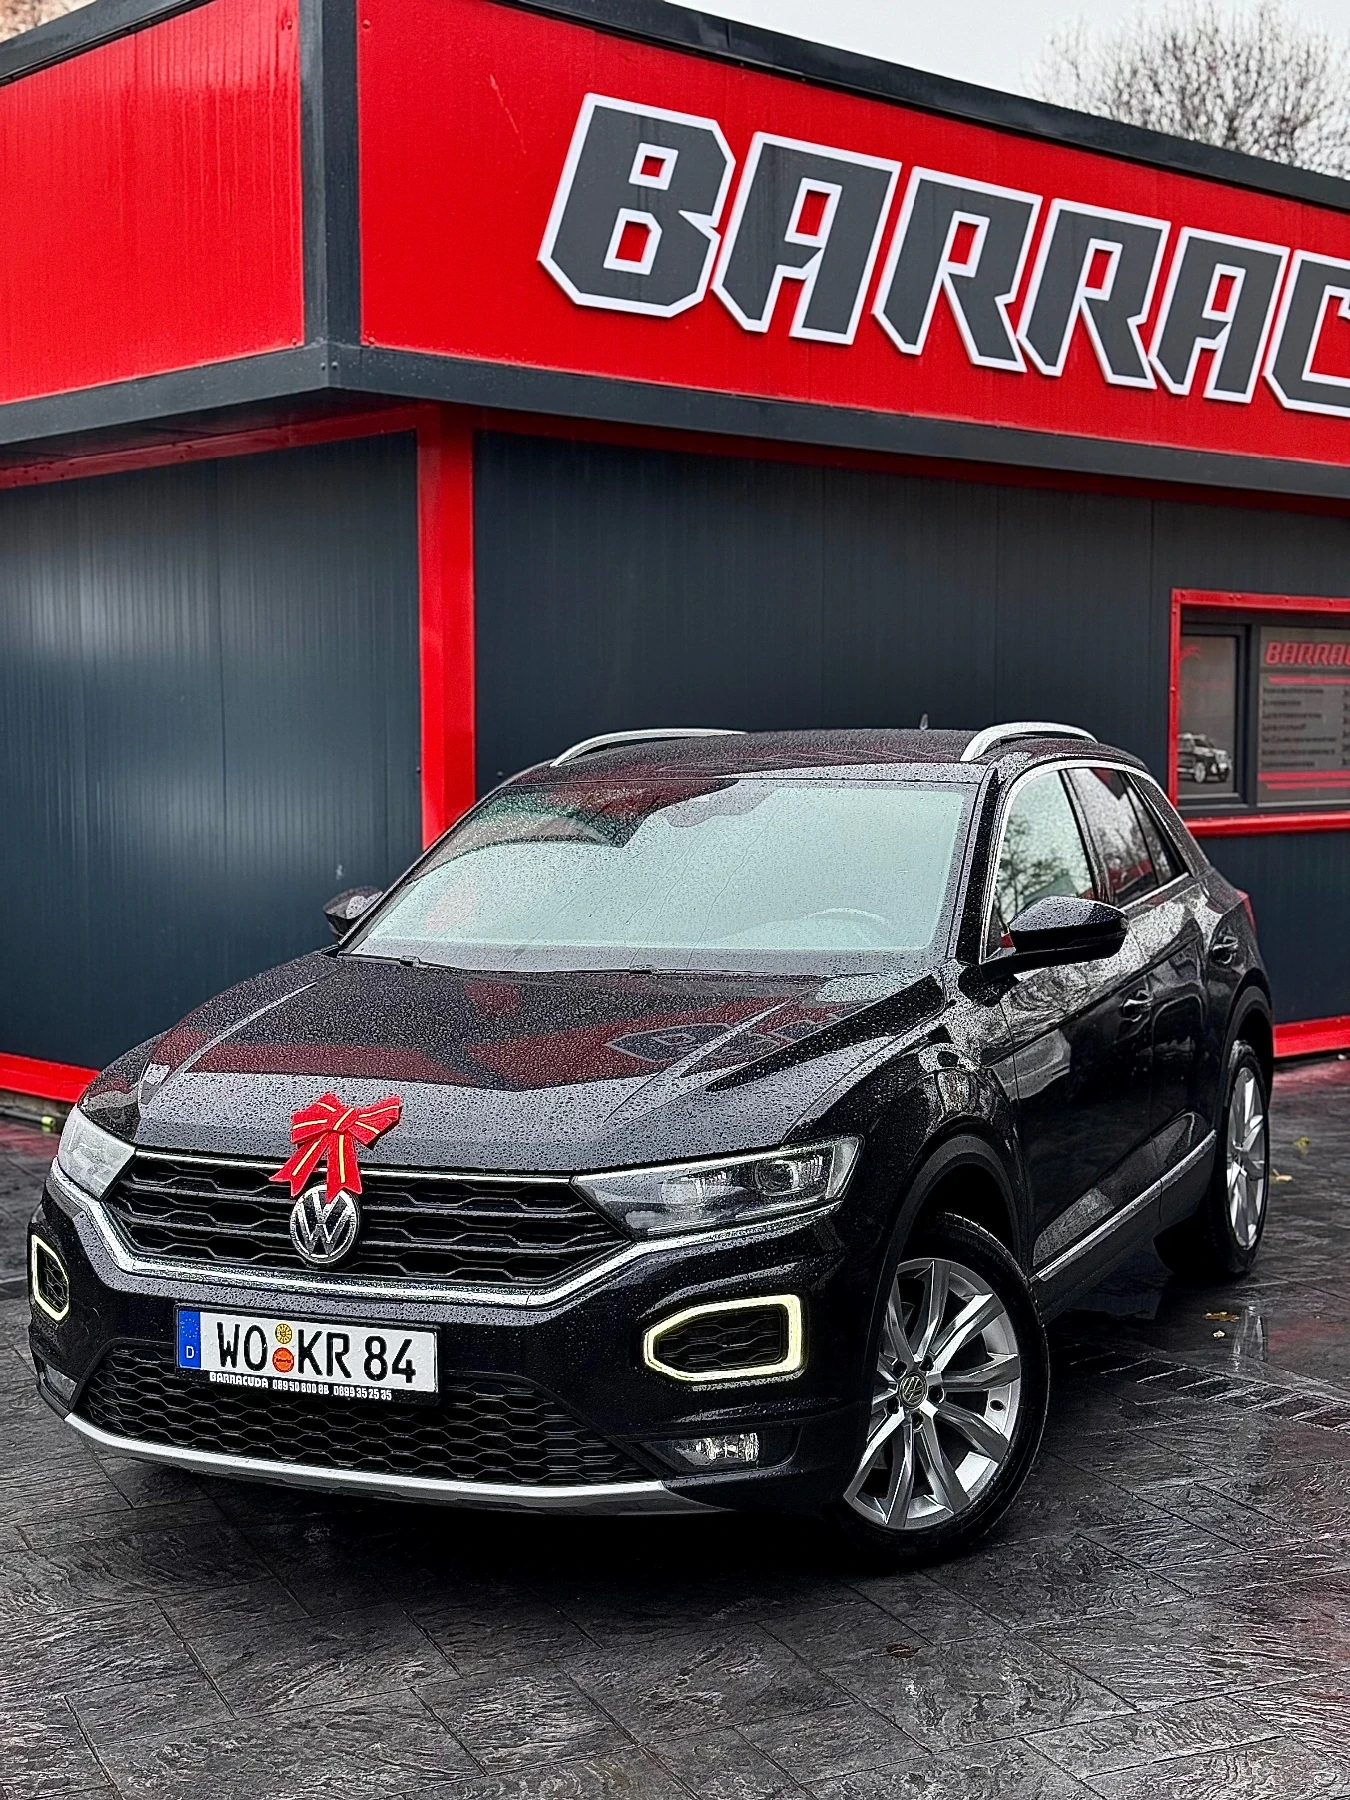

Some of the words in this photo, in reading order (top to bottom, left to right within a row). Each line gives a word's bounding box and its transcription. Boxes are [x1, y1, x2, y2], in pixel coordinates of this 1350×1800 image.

[1265, 641, 1350, 666] BARRA
[186, 1345, 195, 1359] D
[217, 1322, 268, 1371] WO
[297, 1329, 352, 1379] KR
[363, 1335, 416, 1384] 84
[209, 1371, 269, 1389] BARRACUDA
